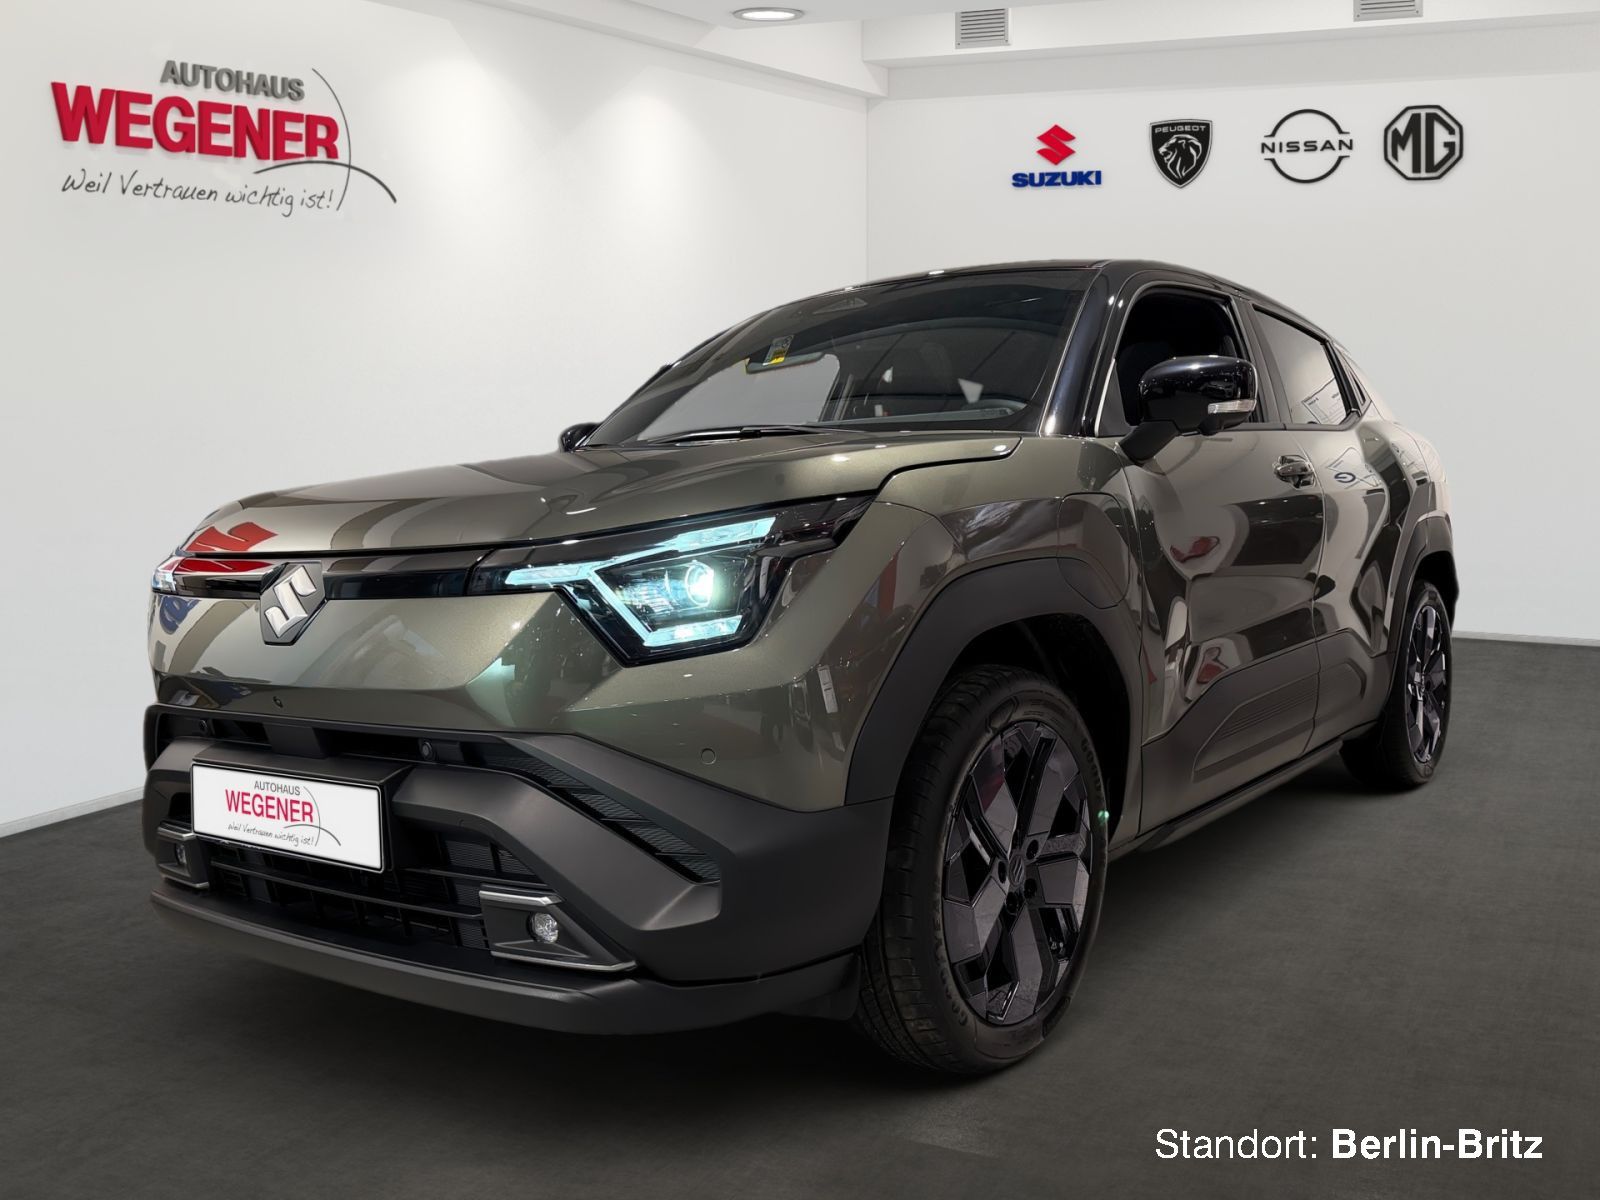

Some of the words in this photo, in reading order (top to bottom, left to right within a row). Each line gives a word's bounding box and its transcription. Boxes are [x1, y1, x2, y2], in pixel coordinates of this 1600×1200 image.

[160, 60, 304, 101] AUTOHAUS
[51, 82, 339, 161] WEGENER
[1154, 125, 1207, 133] PEUGEOT
[1261, 138, 1353, 154] NISSAN
[1391, 112, 1456, 174] MG
[1011, 170, 1102, 188] SUZUKI
[61, 169, 112, 194] Weil
[120, 170, 218, 202] Vertrauen
[225, 184, 294, 217] wichtig
[300, 189, 333, 210] ist!
[254, 780, 301, 795] AUTOHAUS
[225, 789, 314, 823] WEGENER
[243, 826, 273, 838] Vertrauen
